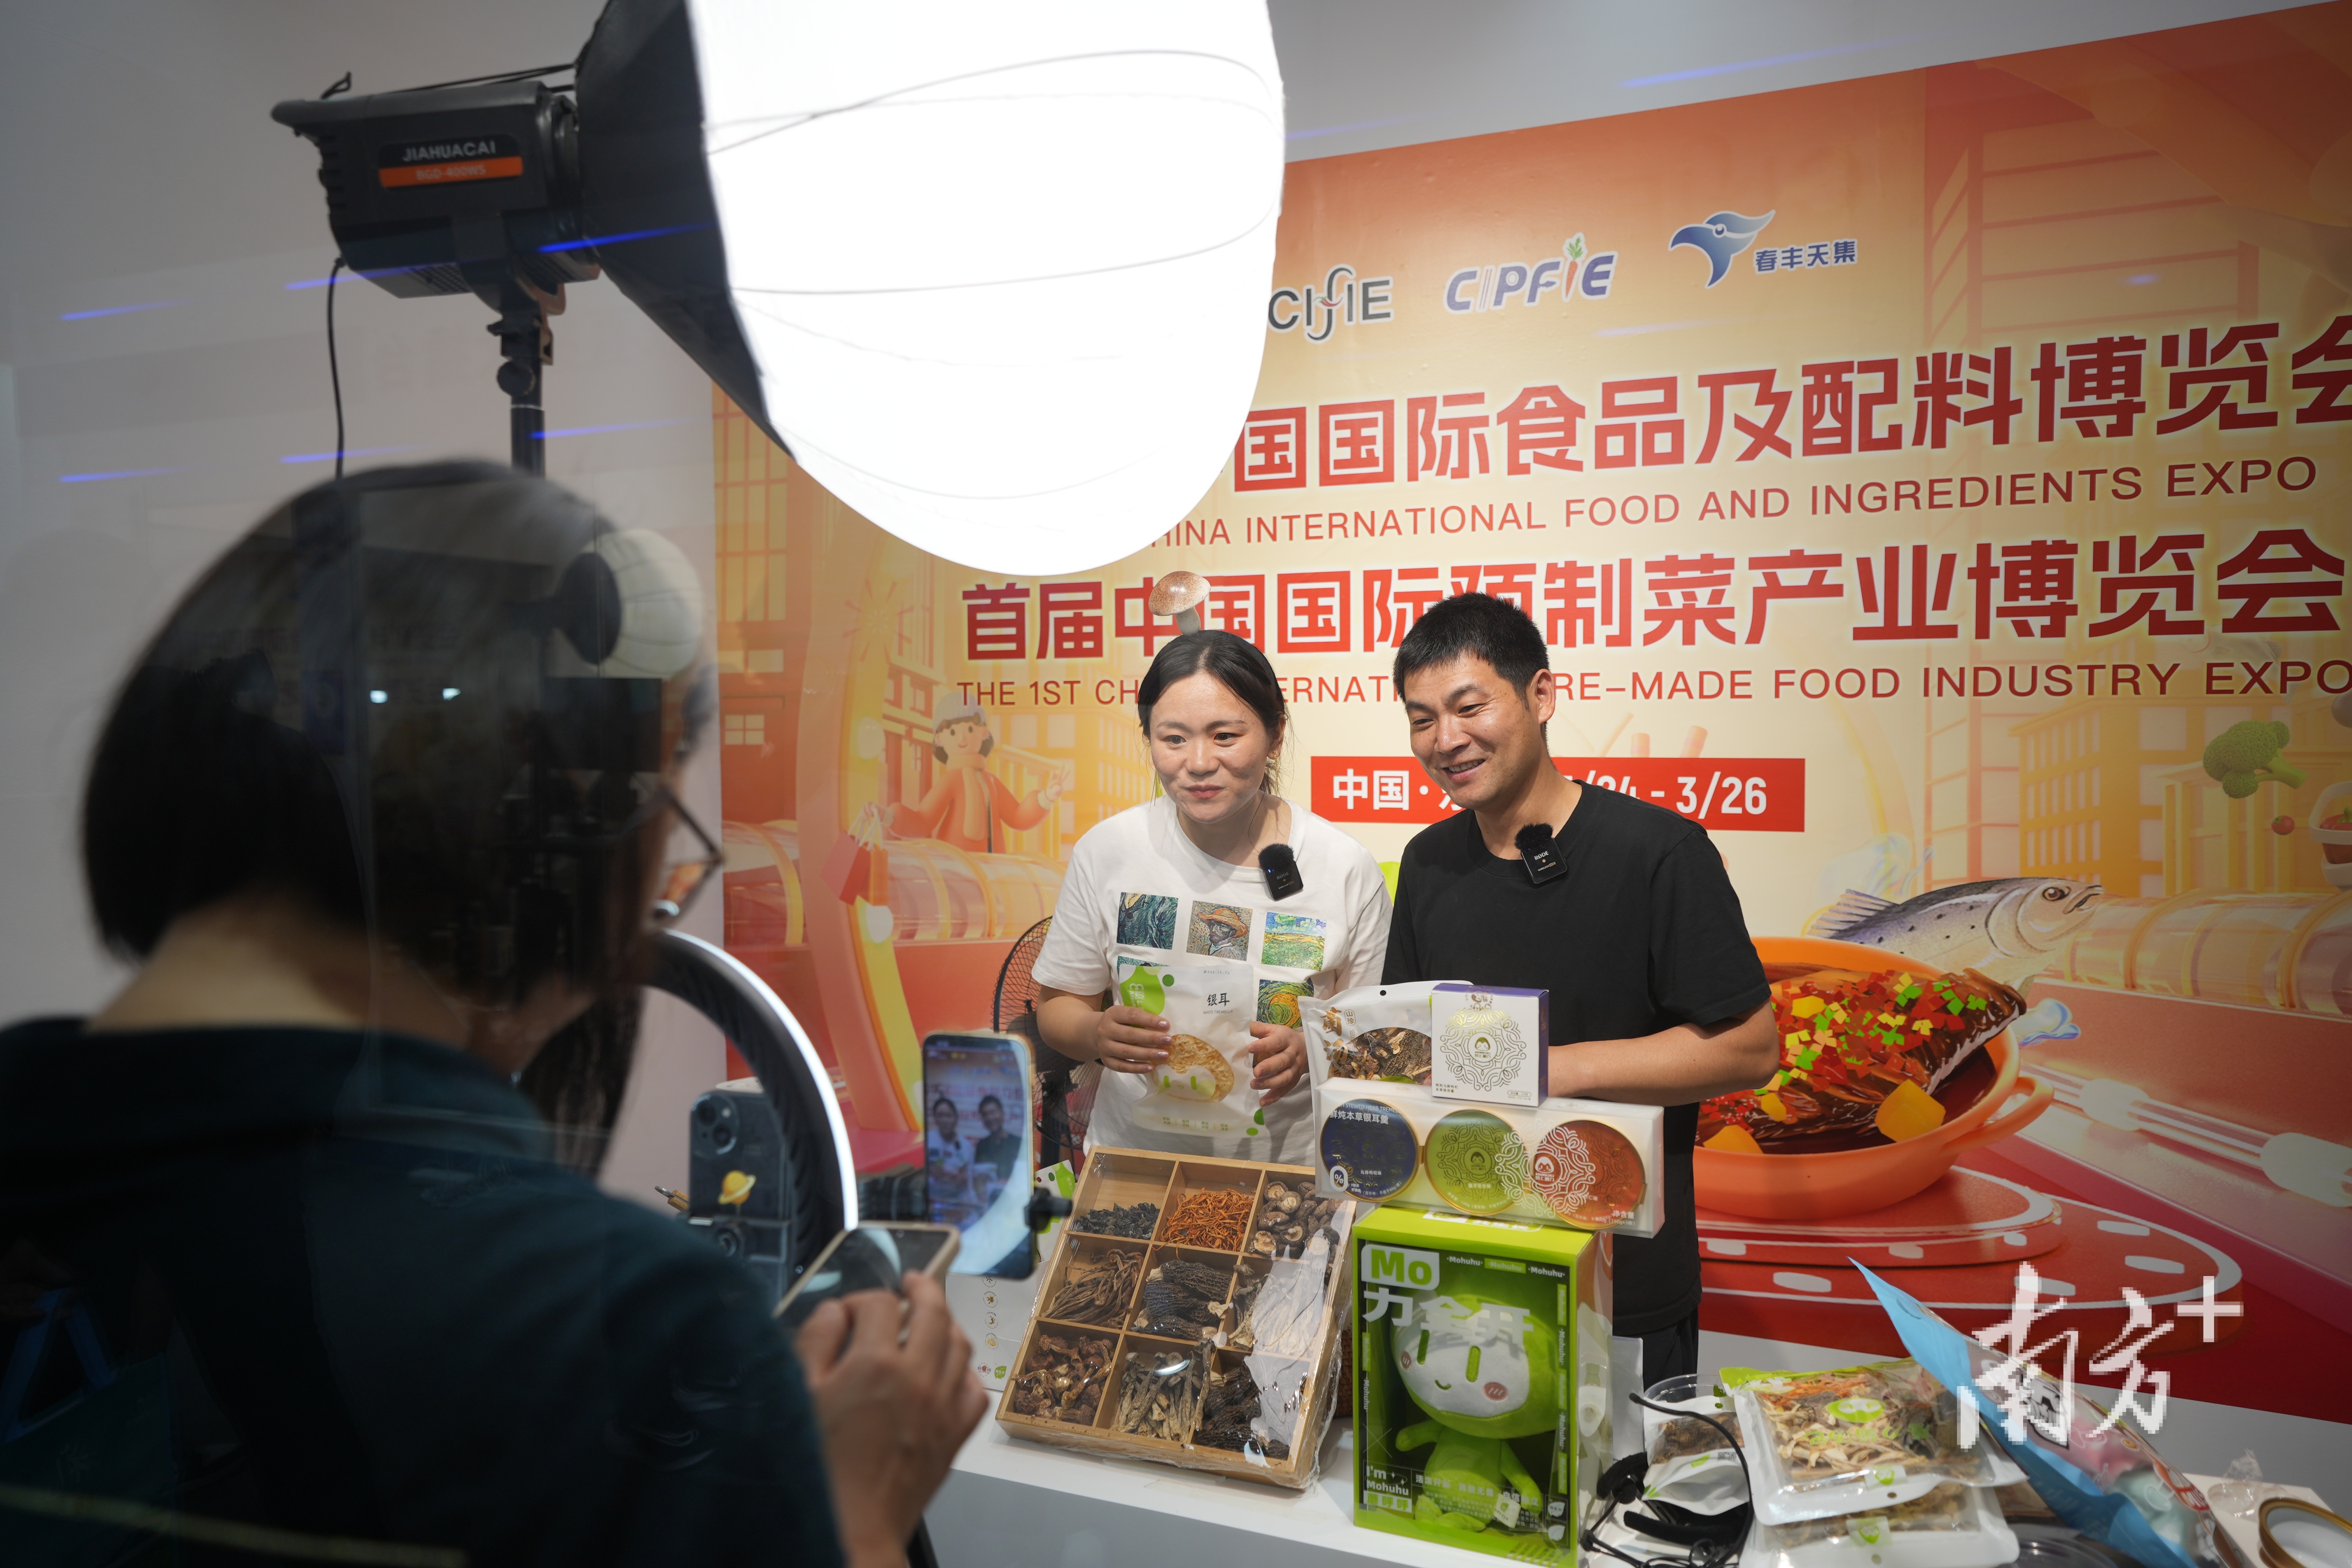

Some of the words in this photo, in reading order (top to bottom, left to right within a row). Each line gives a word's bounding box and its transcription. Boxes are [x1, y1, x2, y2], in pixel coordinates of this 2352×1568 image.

[403, 140, 496, 162] JIAHUACAI
[1755, 240, 1857, 273] 春丰天集
[1221, 315, 2352, 492] 国国际食品及配料博览
[1151, 519, 1230, 548] INA
[1247, 502, 1546, 544] INTERNATIONAL
[1566, 493, 1680, 527] FOOD
[1698, 487, 1790, 521] AND
[1811, 466, 2143, 515] INGREDIENTS
[2167, 456, 2317, 497] EXPO
[1555, 671, 1752, 701] RE-MADE
[1774, 667, 1901, 699] FOOD
[1924, 663, 2181, 698] INDUSTRY
[2206, 660, 2352, 695] EXPO
[957, 682, 1016, 706] THE
[1029, 680, 1081, 705] 1ST
[1676, 771, 1767, 820] 3/26
[1534, 851, 1549, 860] RØDE
[1276, 871, 1290, 880] RØDE
[1207, 993, 1230, 1007] 银耳
[1346, 1011, 1354, 1024] 山珍
[1330, 1110, 1389, 1125] 鲜炖本草银耳羹
[1612, 1210, 1634, 1220] 净含量
[1370, 1248, 1433, 1286] Mo
[1362, 1287, 1534, 1346] 力全开
[1366, 1465, 1387, 1480] I'm
[1366, 1480, 1409, 1496] Mohuhu
